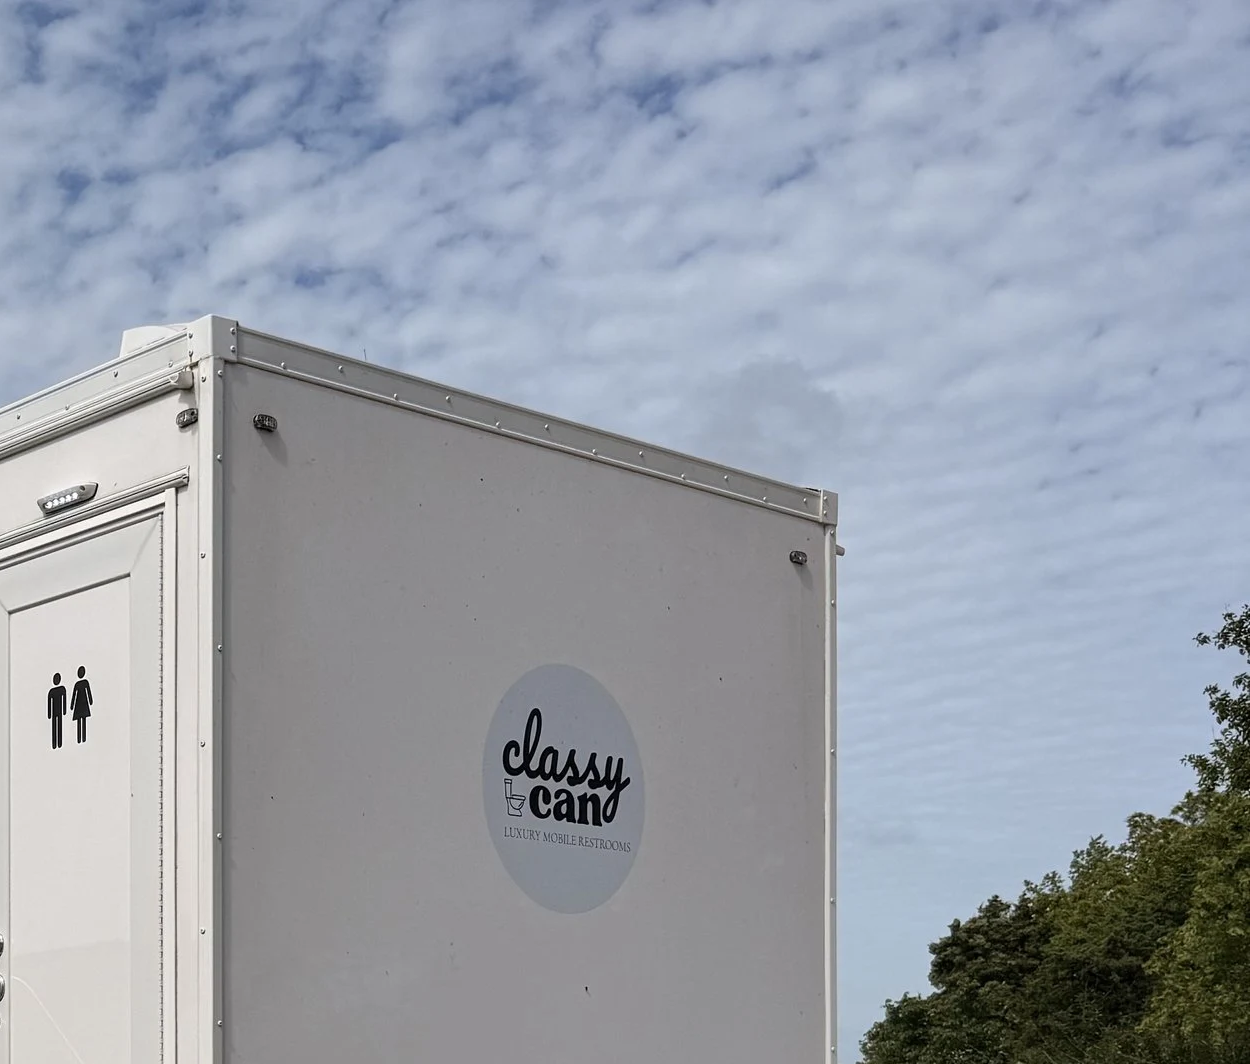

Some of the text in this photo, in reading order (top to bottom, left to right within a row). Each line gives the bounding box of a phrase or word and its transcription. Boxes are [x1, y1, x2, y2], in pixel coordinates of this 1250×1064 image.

[502, 708, 631, 823] classy
[529, 785, 603, 827] can
[504, 826, 631, 853] LUXURY MOBILE RESTROOMS
